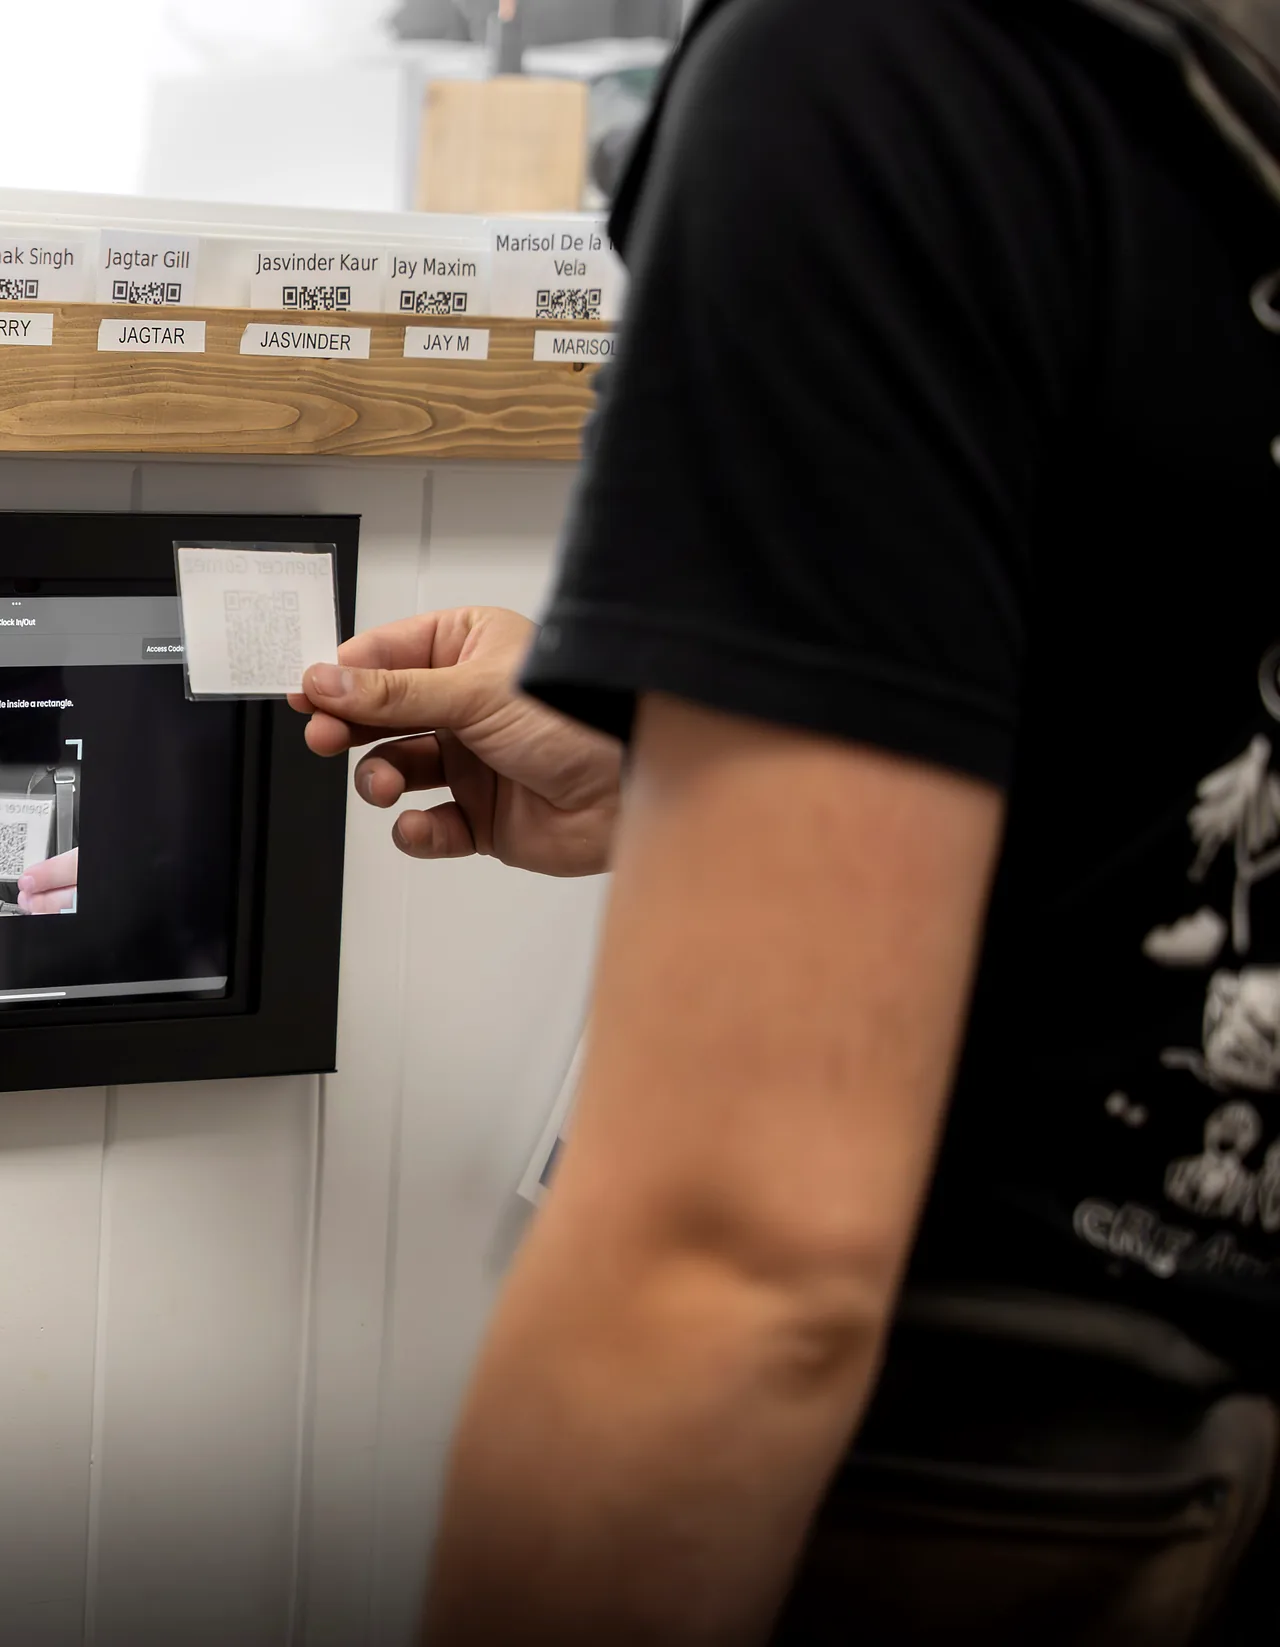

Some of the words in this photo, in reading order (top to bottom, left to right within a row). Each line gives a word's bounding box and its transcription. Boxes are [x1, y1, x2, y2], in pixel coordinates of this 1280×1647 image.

[496, 233, 555, 251] Marisol
[560, 234, 584, 251] De
[588, 233, 602, 251] la
[29, 247, 74, 269] Singh
[105, 248, 158, 270] Jagtar
[163, 250, 190, 269] Gill
[256, 252, 335, 275] Jasvinder
[340, 253, 379, 272] Kaur
[553, 258, 587, 276] Vela
[391, 256, 417, 279] Jay
[423, 257, 477, 277] Maxim
[118, 326, 185, 345] JAGTAR
[260, 330, 351, 351] JASVINDER
[423, 334, 454, 352] JAY
[457, 335, 470, 352] M
[552, 338, 617, 356] MARISOL
[15, 618, 36, 627] In/Out
[146, 645, 168, 653] Access
[168, 644, 185, 652] Code
[6, 699, 29, 708] inside
[30, 700, 36, 708] a
[37, 699, 74, 709] rectangle.
